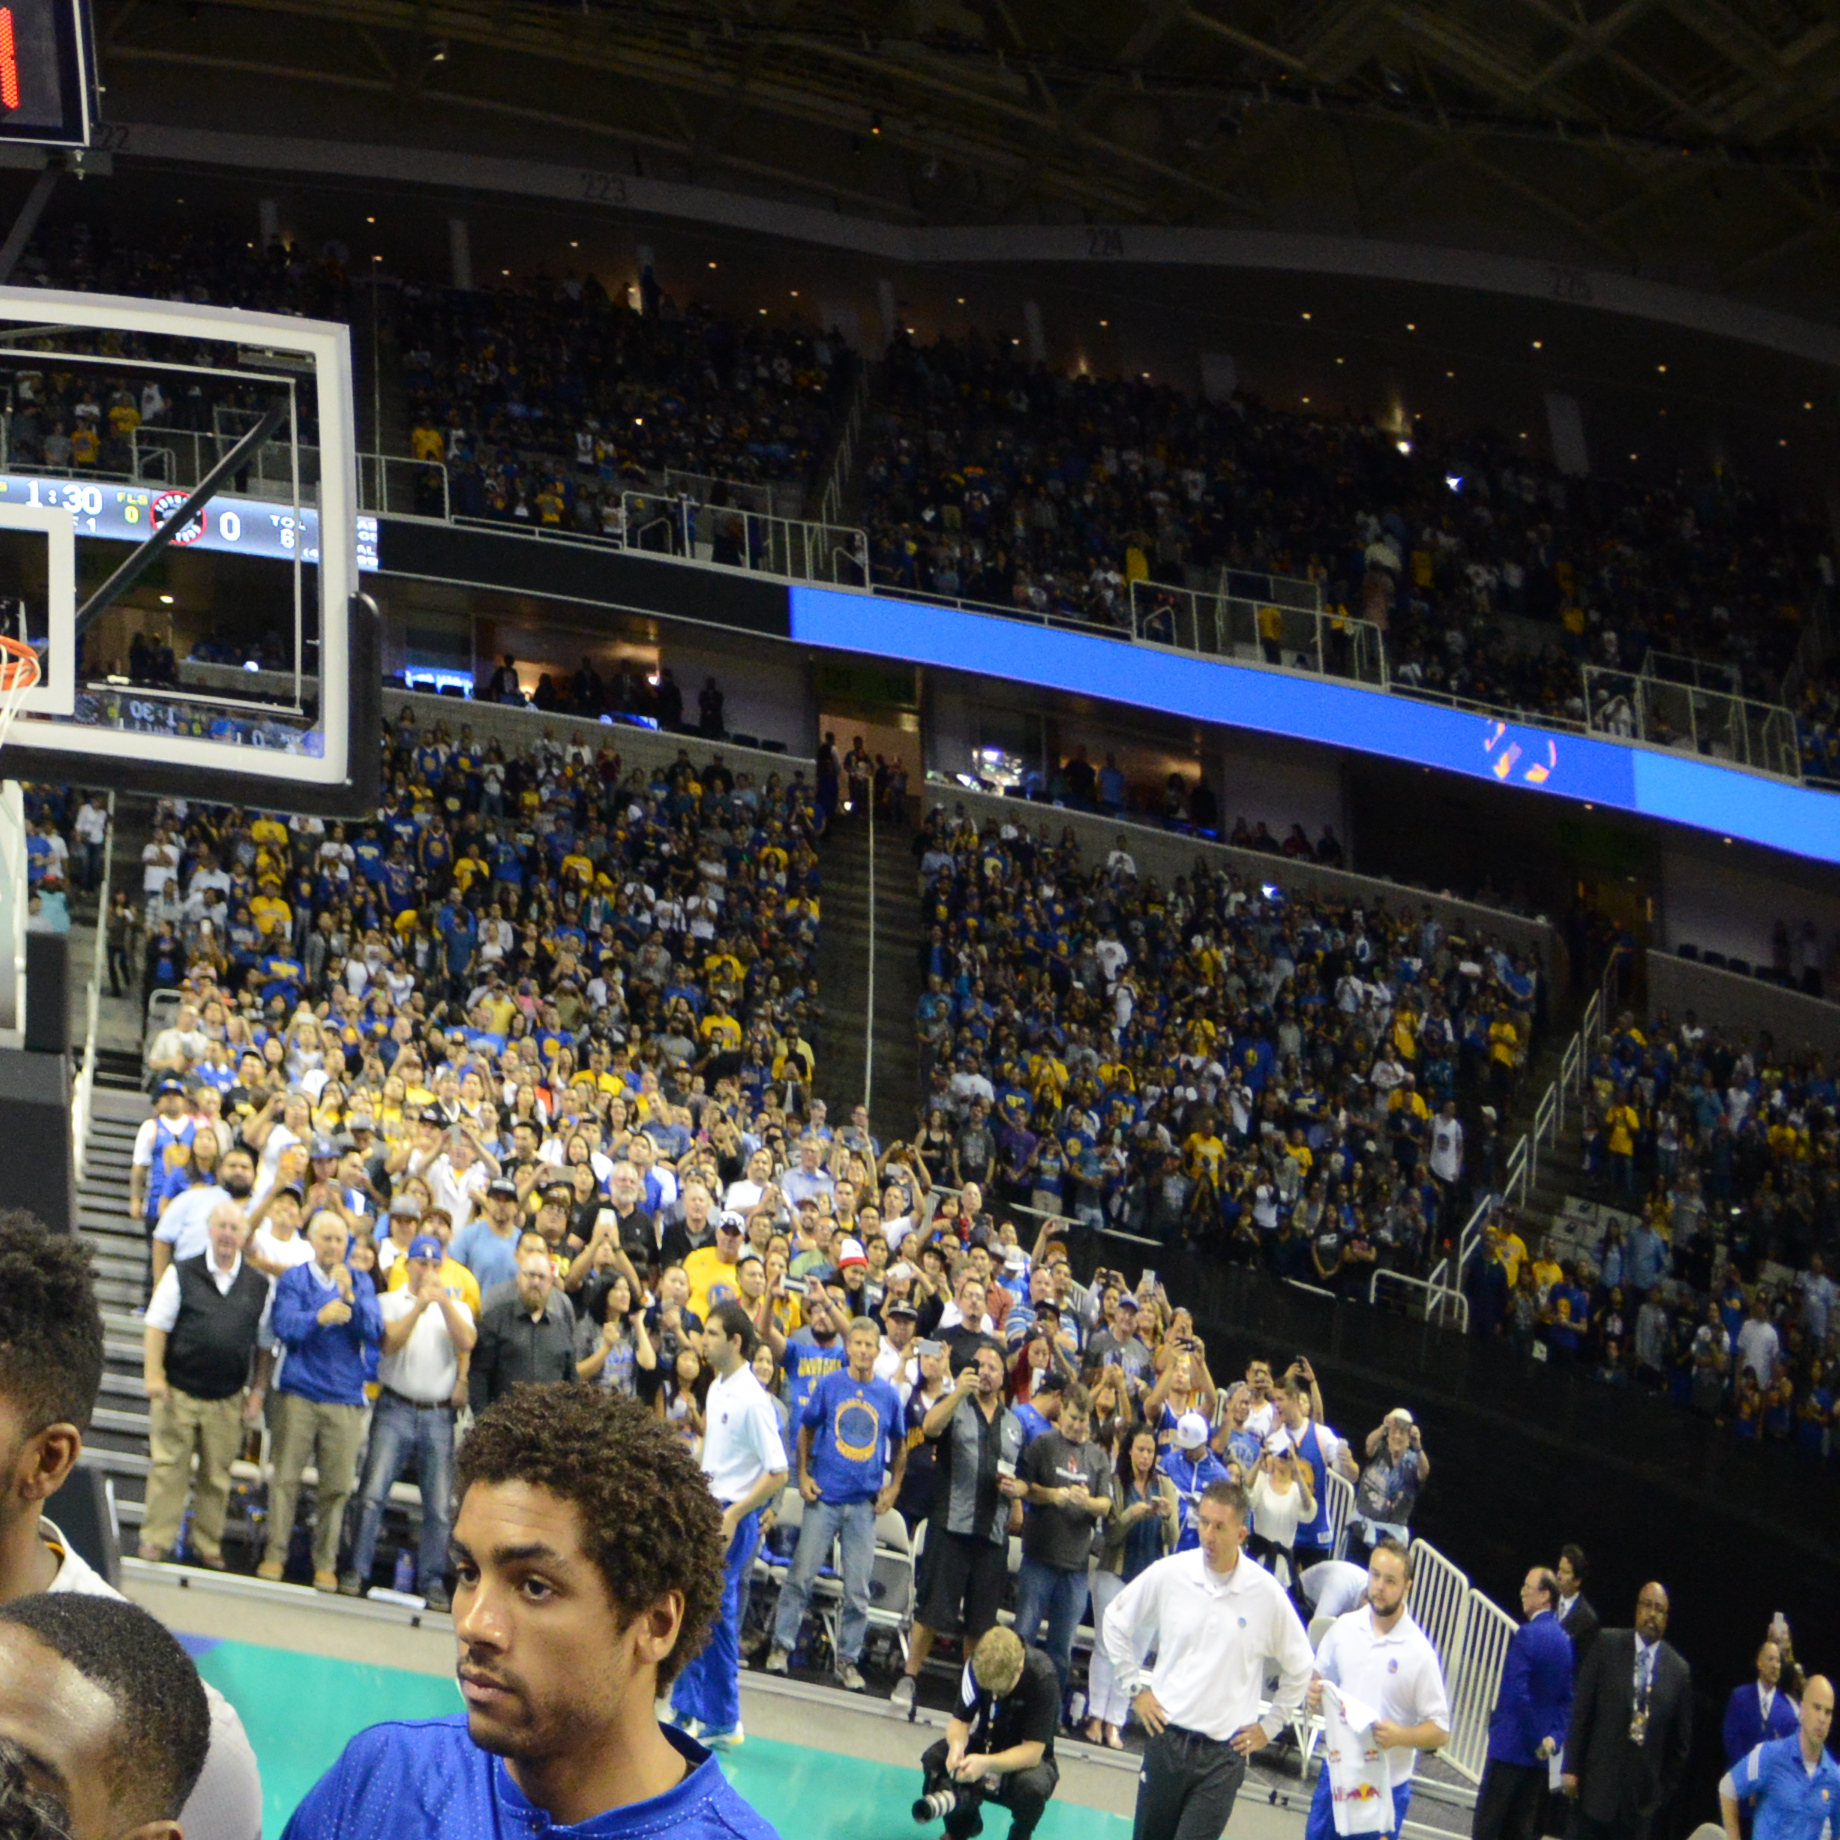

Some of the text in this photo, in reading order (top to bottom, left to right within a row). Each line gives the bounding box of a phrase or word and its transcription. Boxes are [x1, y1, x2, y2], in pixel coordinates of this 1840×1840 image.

[25, 481, 103, 515] 1:30
[124, 505, 139, 524] 0
[219, 511, 241, 541] 0
